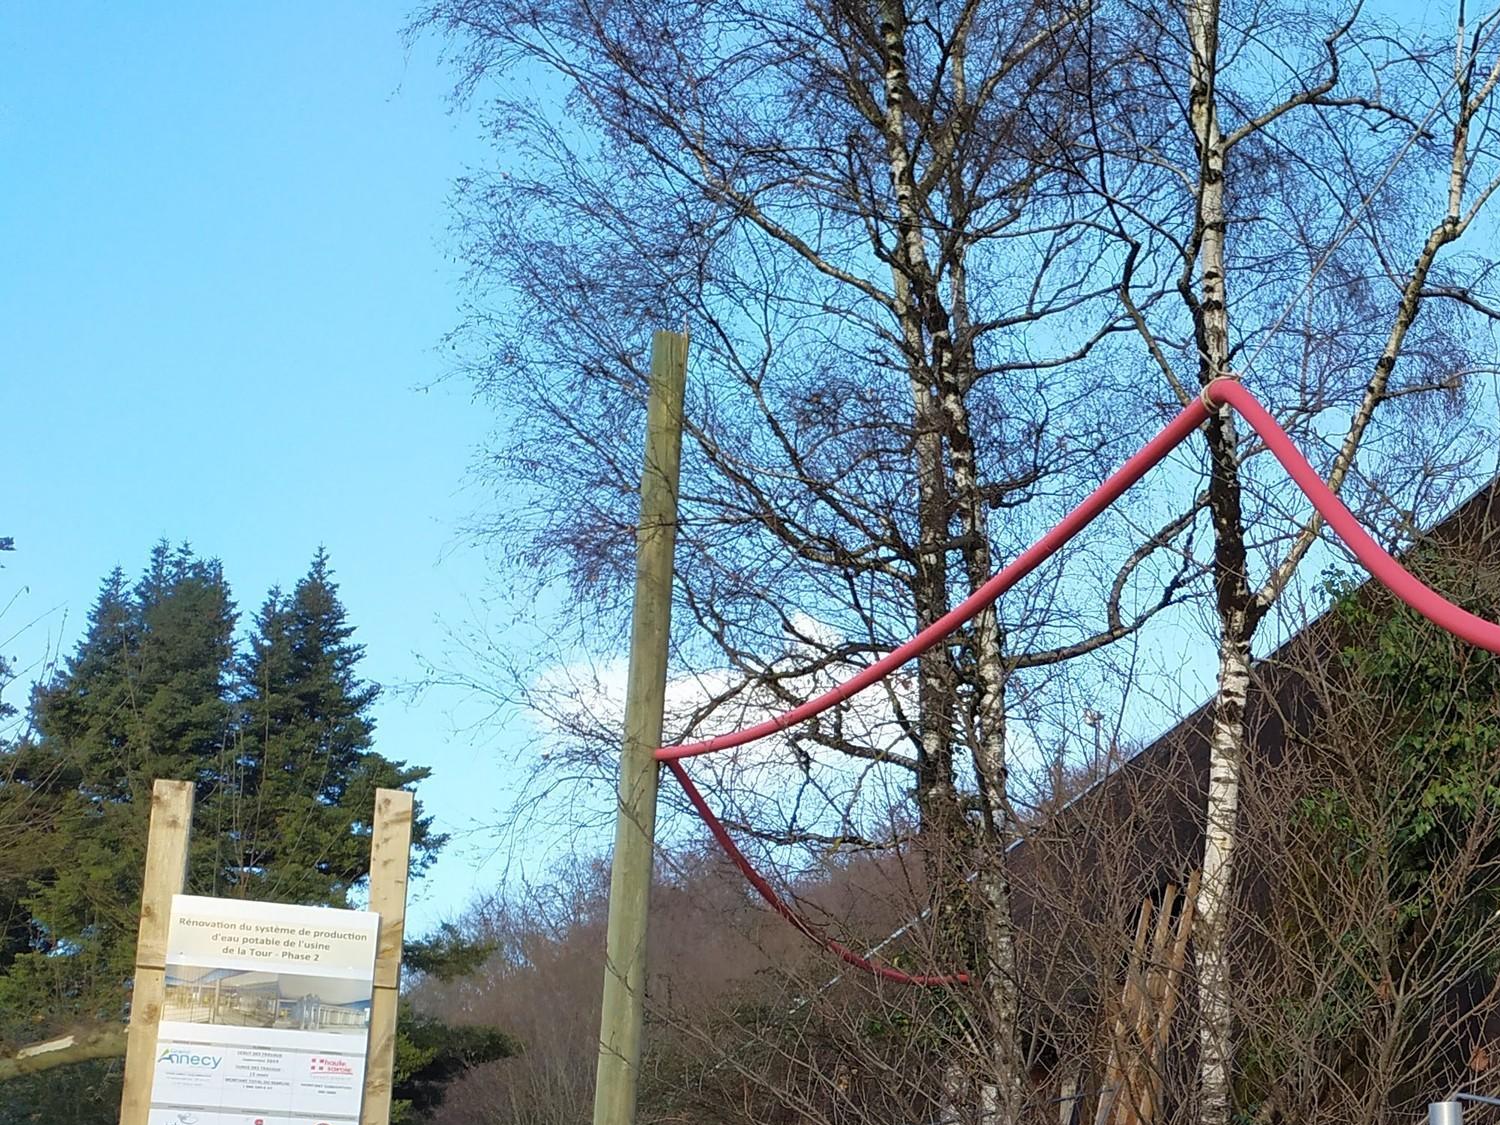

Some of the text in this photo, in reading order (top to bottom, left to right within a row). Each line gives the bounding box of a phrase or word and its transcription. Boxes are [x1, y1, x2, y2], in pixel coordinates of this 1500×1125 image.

[179, 917, 367, 941] Rénovation du système de production
[211, 933, 330, 951] d'eau potable de l'usine
[222, 946, 235, 954] de
[238, 947, 246, 955] la
[249, 948, 272, 957] Tour
[281, 951, 311, 960] Phase
